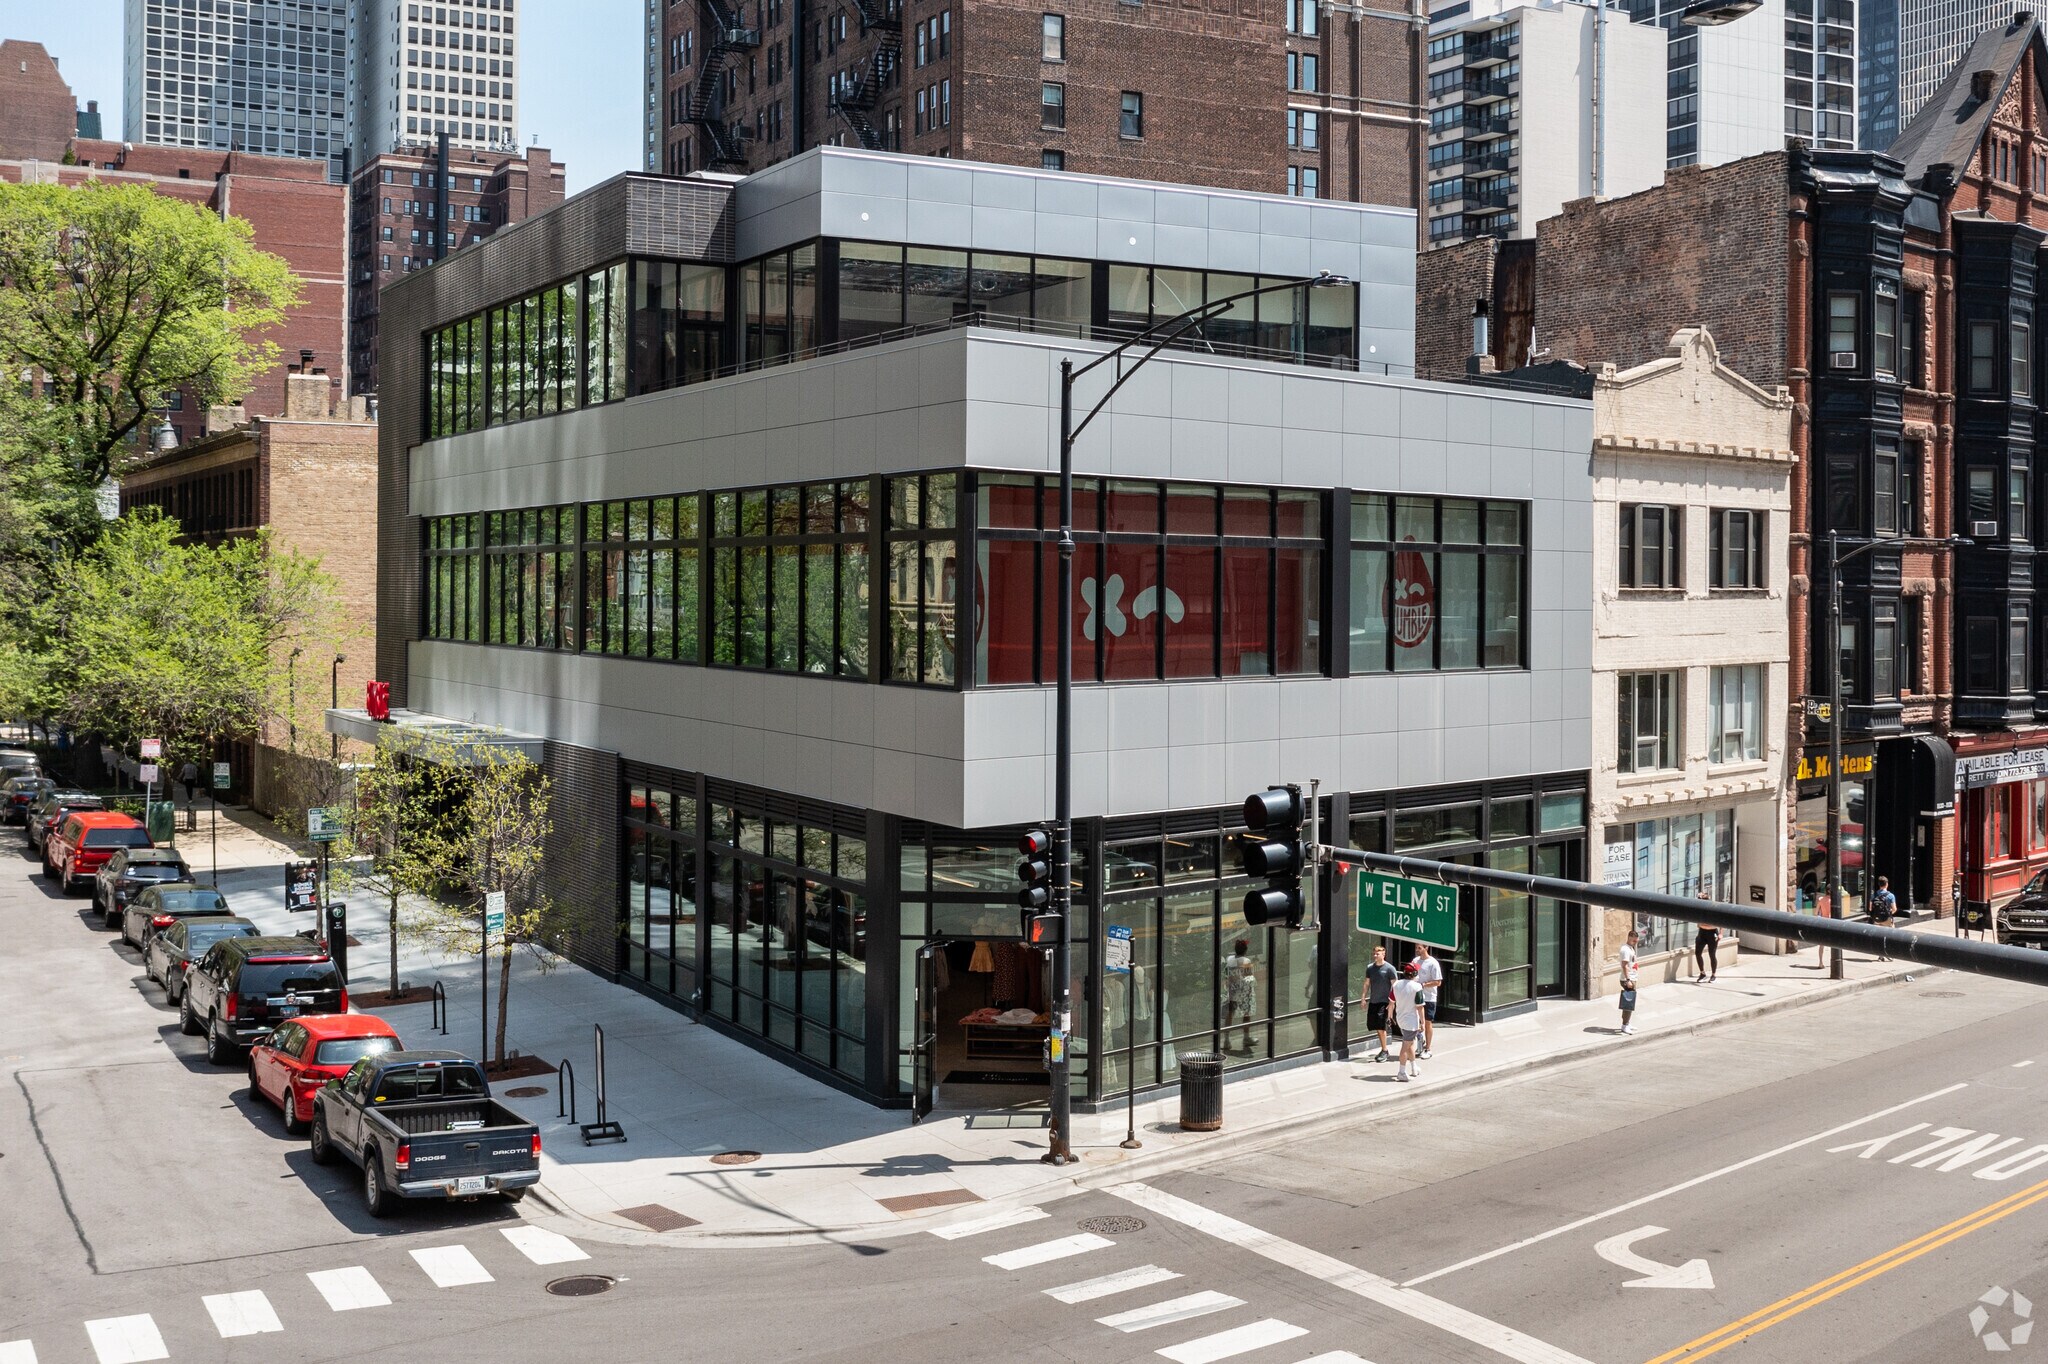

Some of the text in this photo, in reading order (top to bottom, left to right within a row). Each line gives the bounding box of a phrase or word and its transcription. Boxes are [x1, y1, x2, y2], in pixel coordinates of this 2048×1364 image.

[1957, 750, 2044, 773] AVAILABLE FOR LEASE
[1956, 773, 1984, 785] JARETT
[1986, 769, 2009, 780] FRADIN
[1608, 845, 1625, 854] FOR
[1365, 881, 1450, 912] W ELM ST
[1388, 912, 1425, 934] 1142 N
[492, 1148, 528, 1156] DAKOTA
[1825, 1122, 2048, 1181] ONLY
